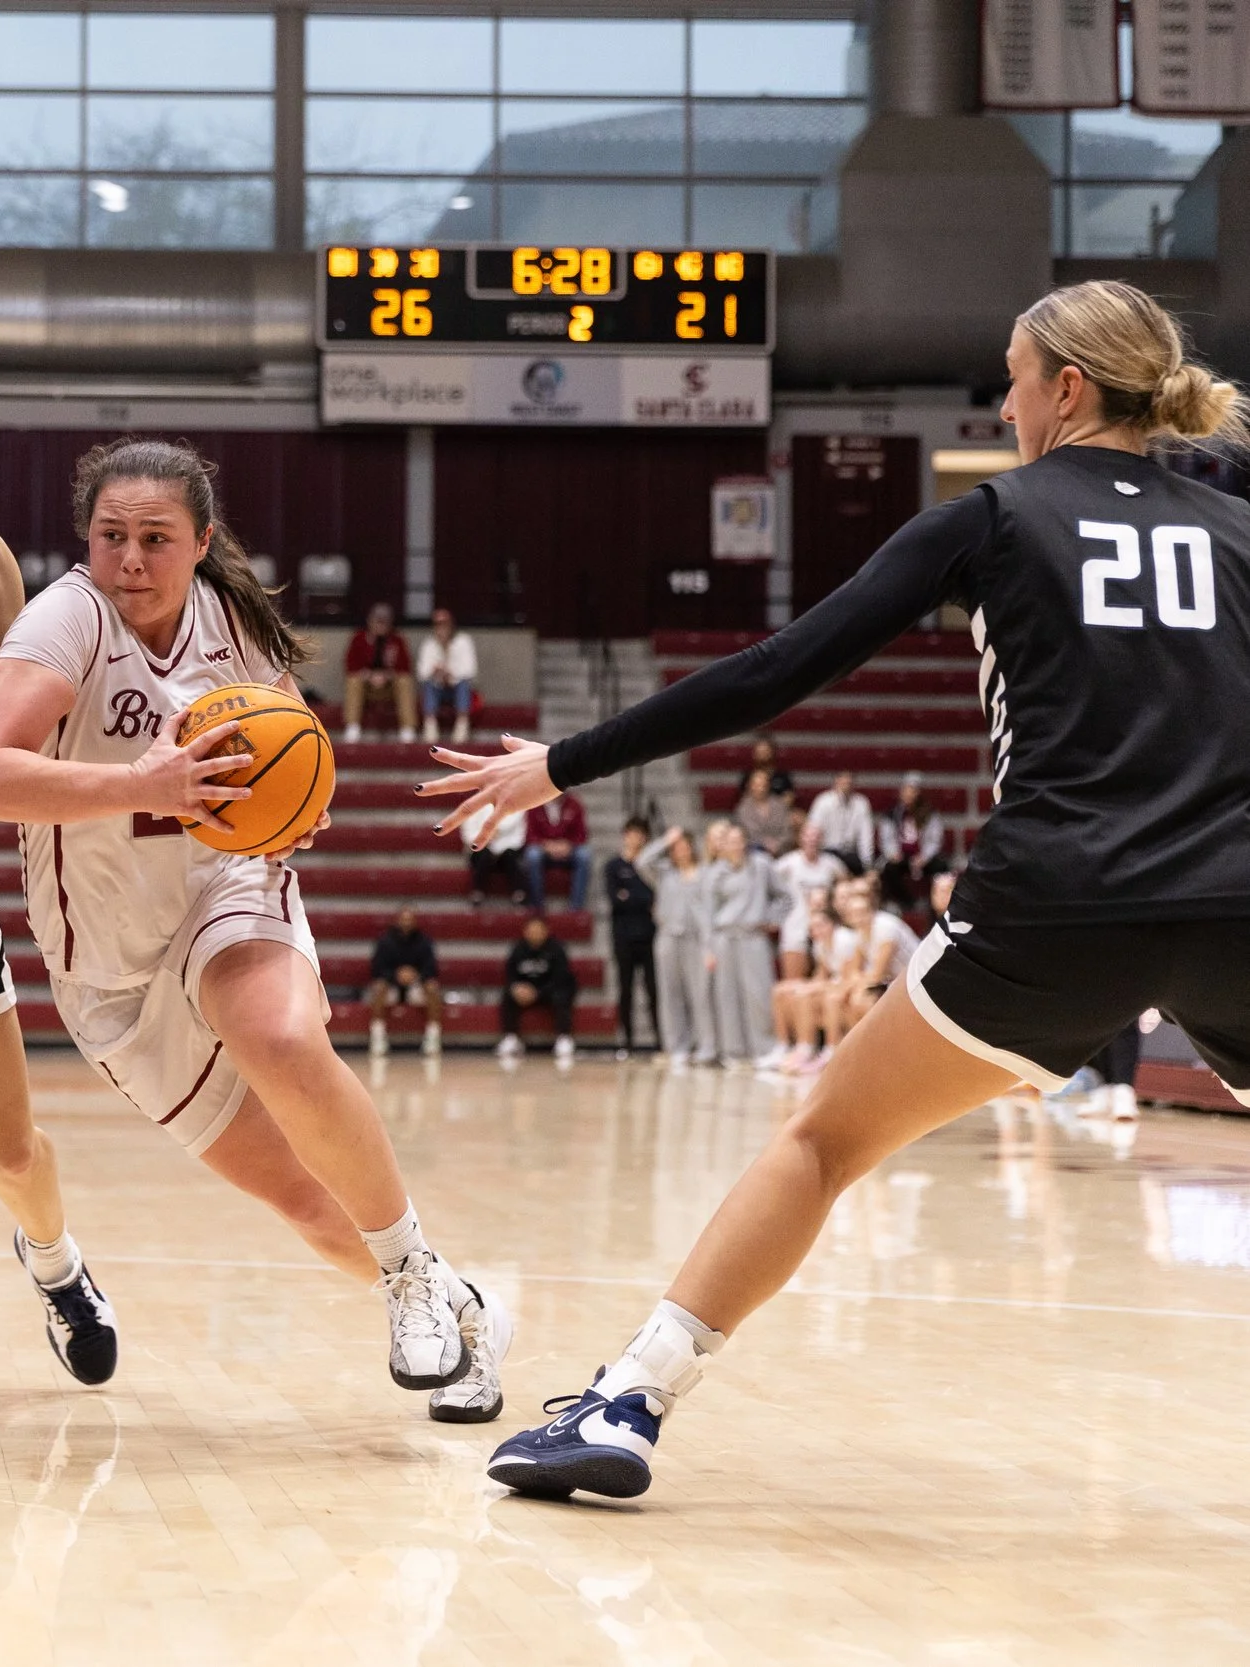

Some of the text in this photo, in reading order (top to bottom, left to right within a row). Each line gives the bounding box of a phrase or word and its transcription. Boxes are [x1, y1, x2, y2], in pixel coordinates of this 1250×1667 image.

[513, 247, 611, 296] 6:28
[371, 289, 433, 336] 26
[569, 306, 594, 341] 2
[676, 292, 737, 338] 21
[1079, 520, 1216, 629] 20
[204, 646, 232, 663] WCC
